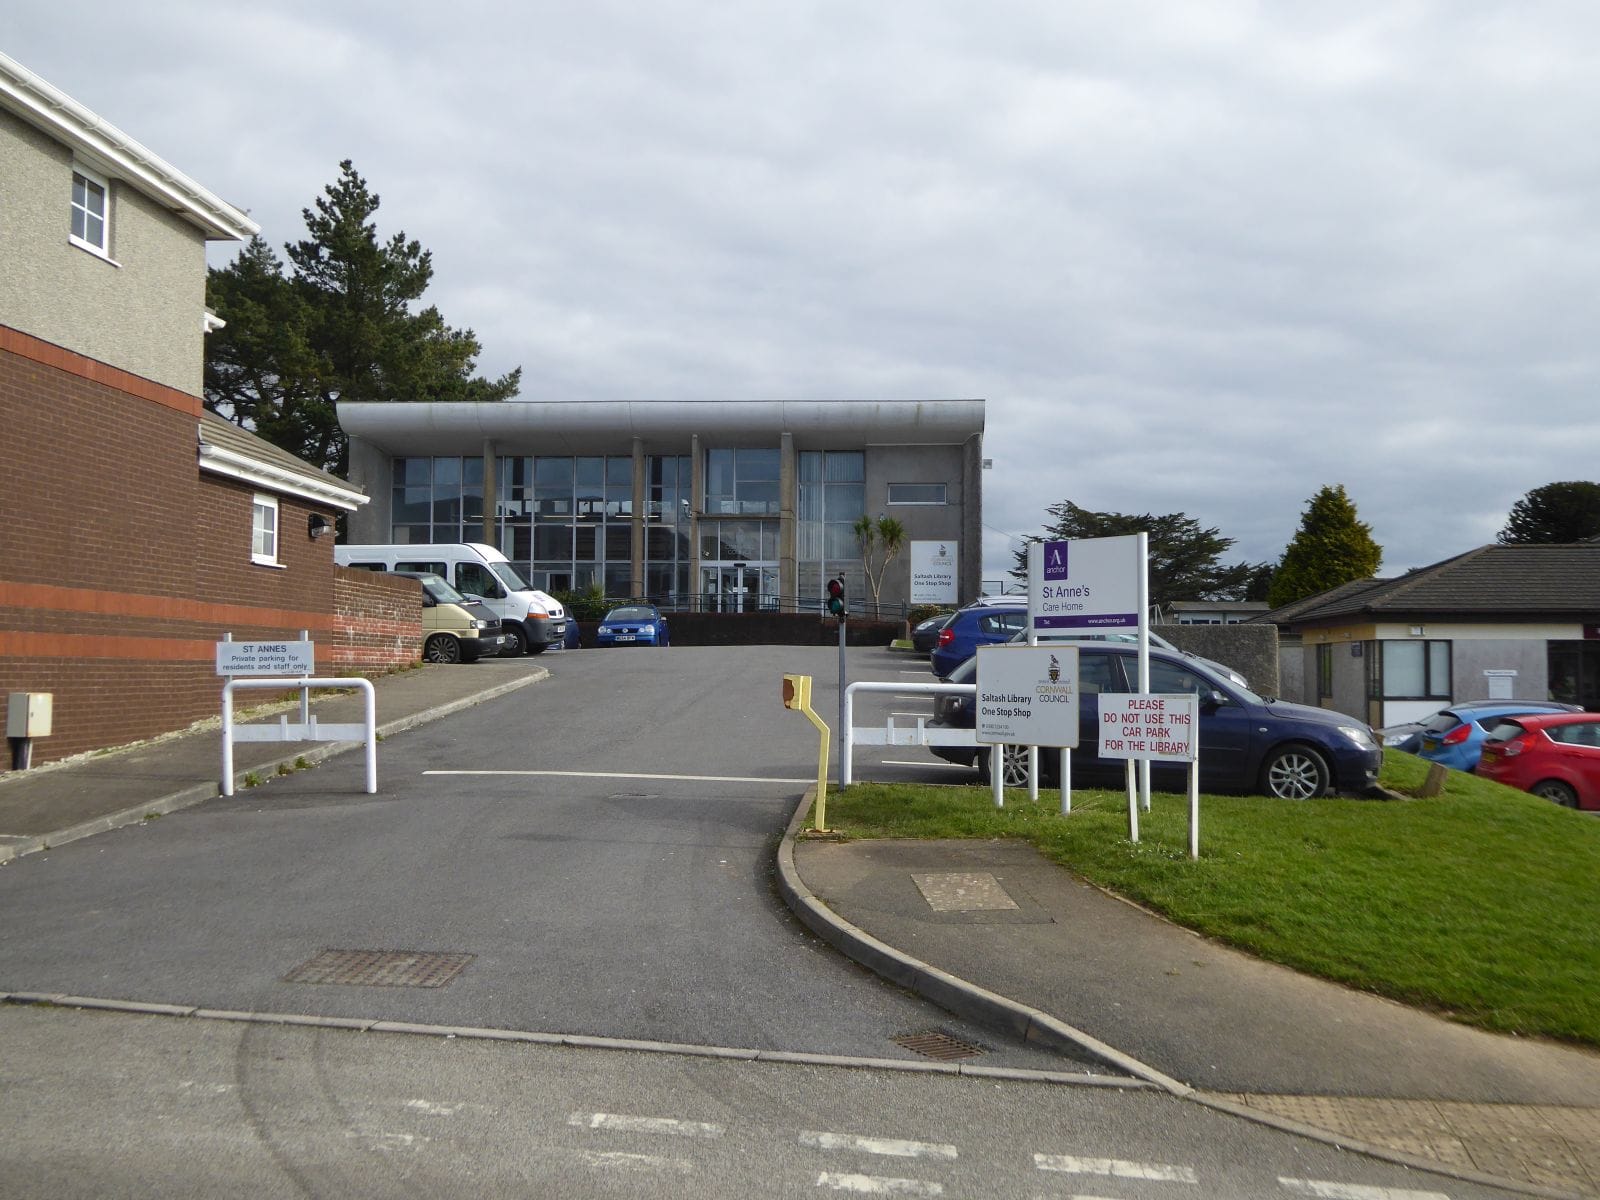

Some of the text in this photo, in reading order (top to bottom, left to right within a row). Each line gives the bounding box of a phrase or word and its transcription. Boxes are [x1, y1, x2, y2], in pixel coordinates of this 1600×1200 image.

[1043, 585, 1089, 598] St Anne's
[1043, 602, 1083, 611] Care Home
[1036, 686, 1072, 694] CORNWALL
[982, 694, 1031, 705] Saltash Library
[1039, 695, 1069, 703] COUNCIL
[1129, 700, 1164, 709] PLEASE
[997, 708, 1012, 718] Stop
[1014, 708, 1031, 718] Shop
[1104, 713, 1190, 724] DO NOT USE THIS
[1123, 727, 1170, 737] CAR PARK
[1106, 740, 1189, 752] FOR THE LIBRARY
